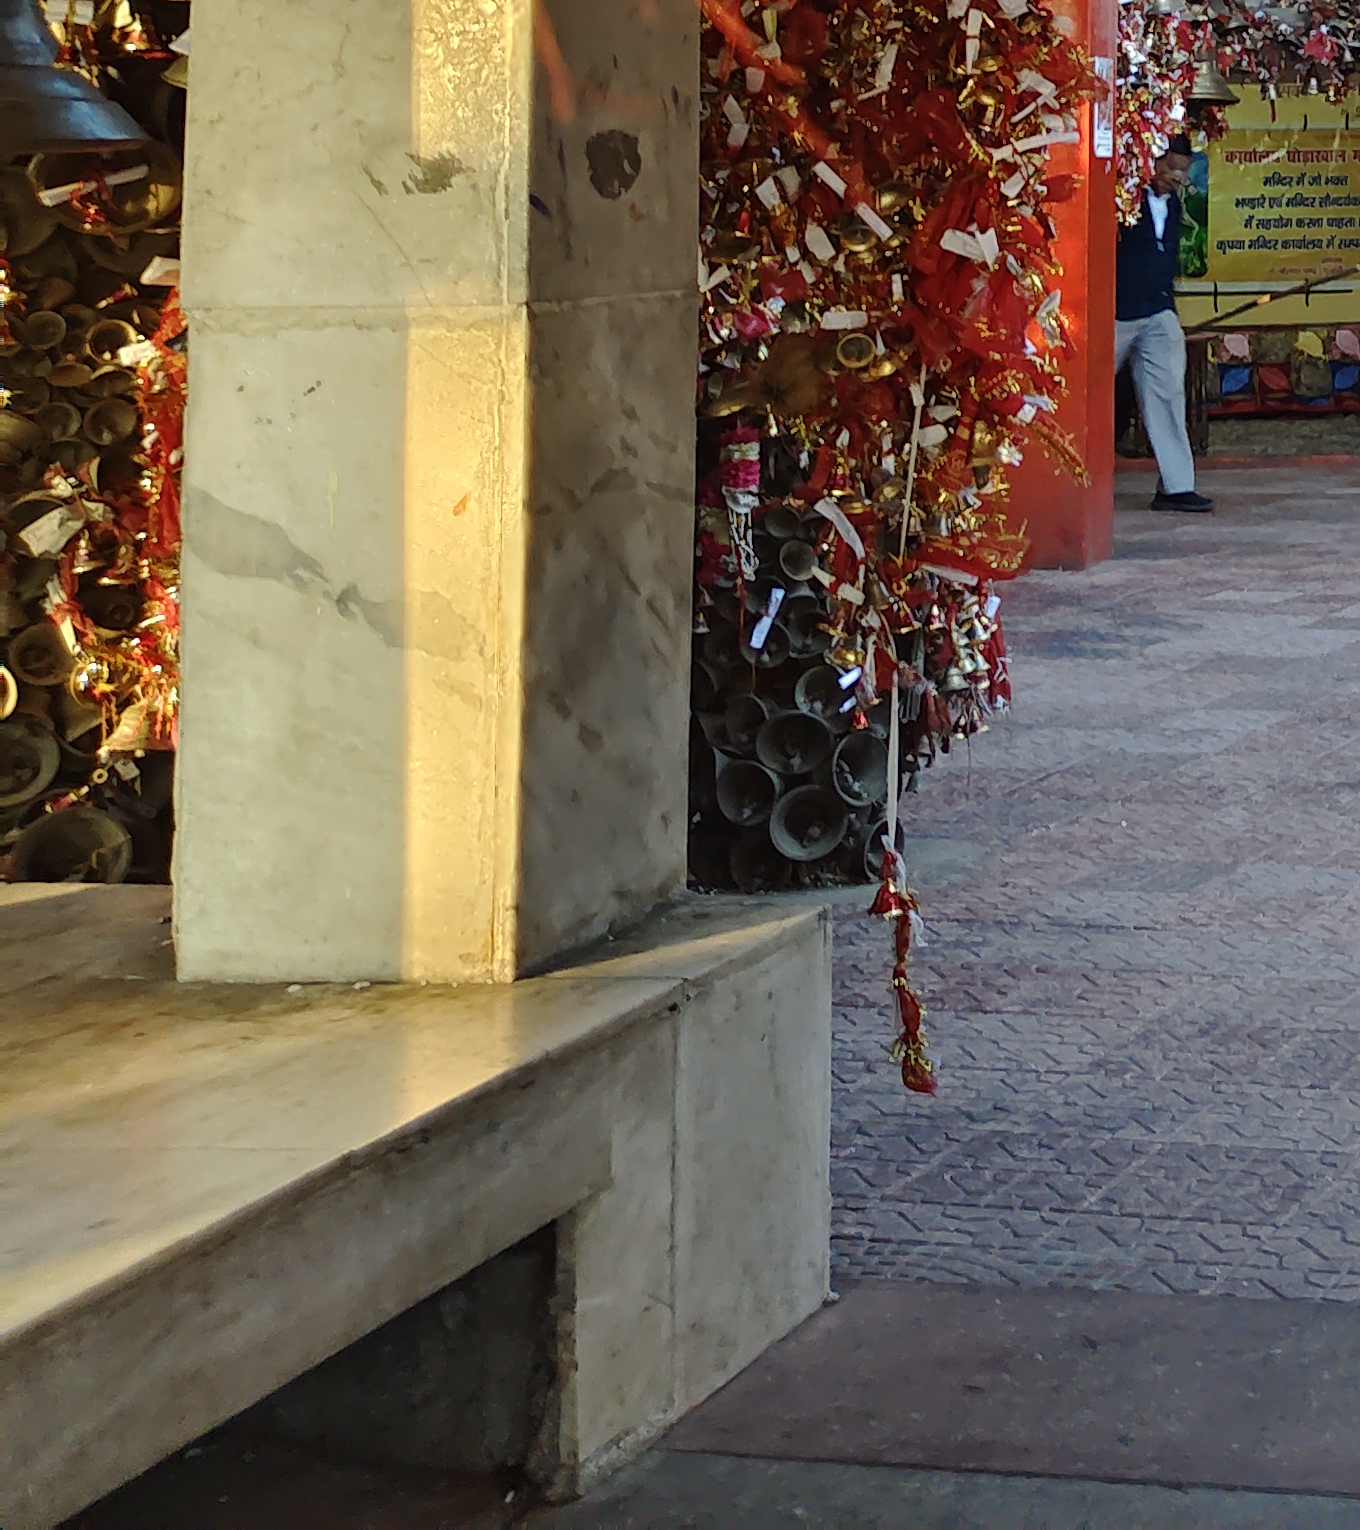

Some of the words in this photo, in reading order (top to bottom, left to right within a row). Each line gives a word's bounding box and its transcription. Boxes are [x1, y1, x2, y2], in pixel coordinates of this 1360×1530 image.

[1263, 171, 1293, 187] मन्दिर
[1296, 172, 1307, 187] में
[1308, 171, 1322, 186] जो
[1286, 192, 1316, 208] मन्दिर
[1244, 214, 1255, 229] में
[1256, 213, 1293, 230] सहयोग
[1296, 217, 1323, 228] करना
[1326, 217, 1356, 229] चाहता
[1216, 239, 1245, 255] कृपया
[1248, 235, 1279, 250] मन्दिर
[1281, 234, 1323, 250] कार्यालय
[1326, 234, 1337, 249] में
